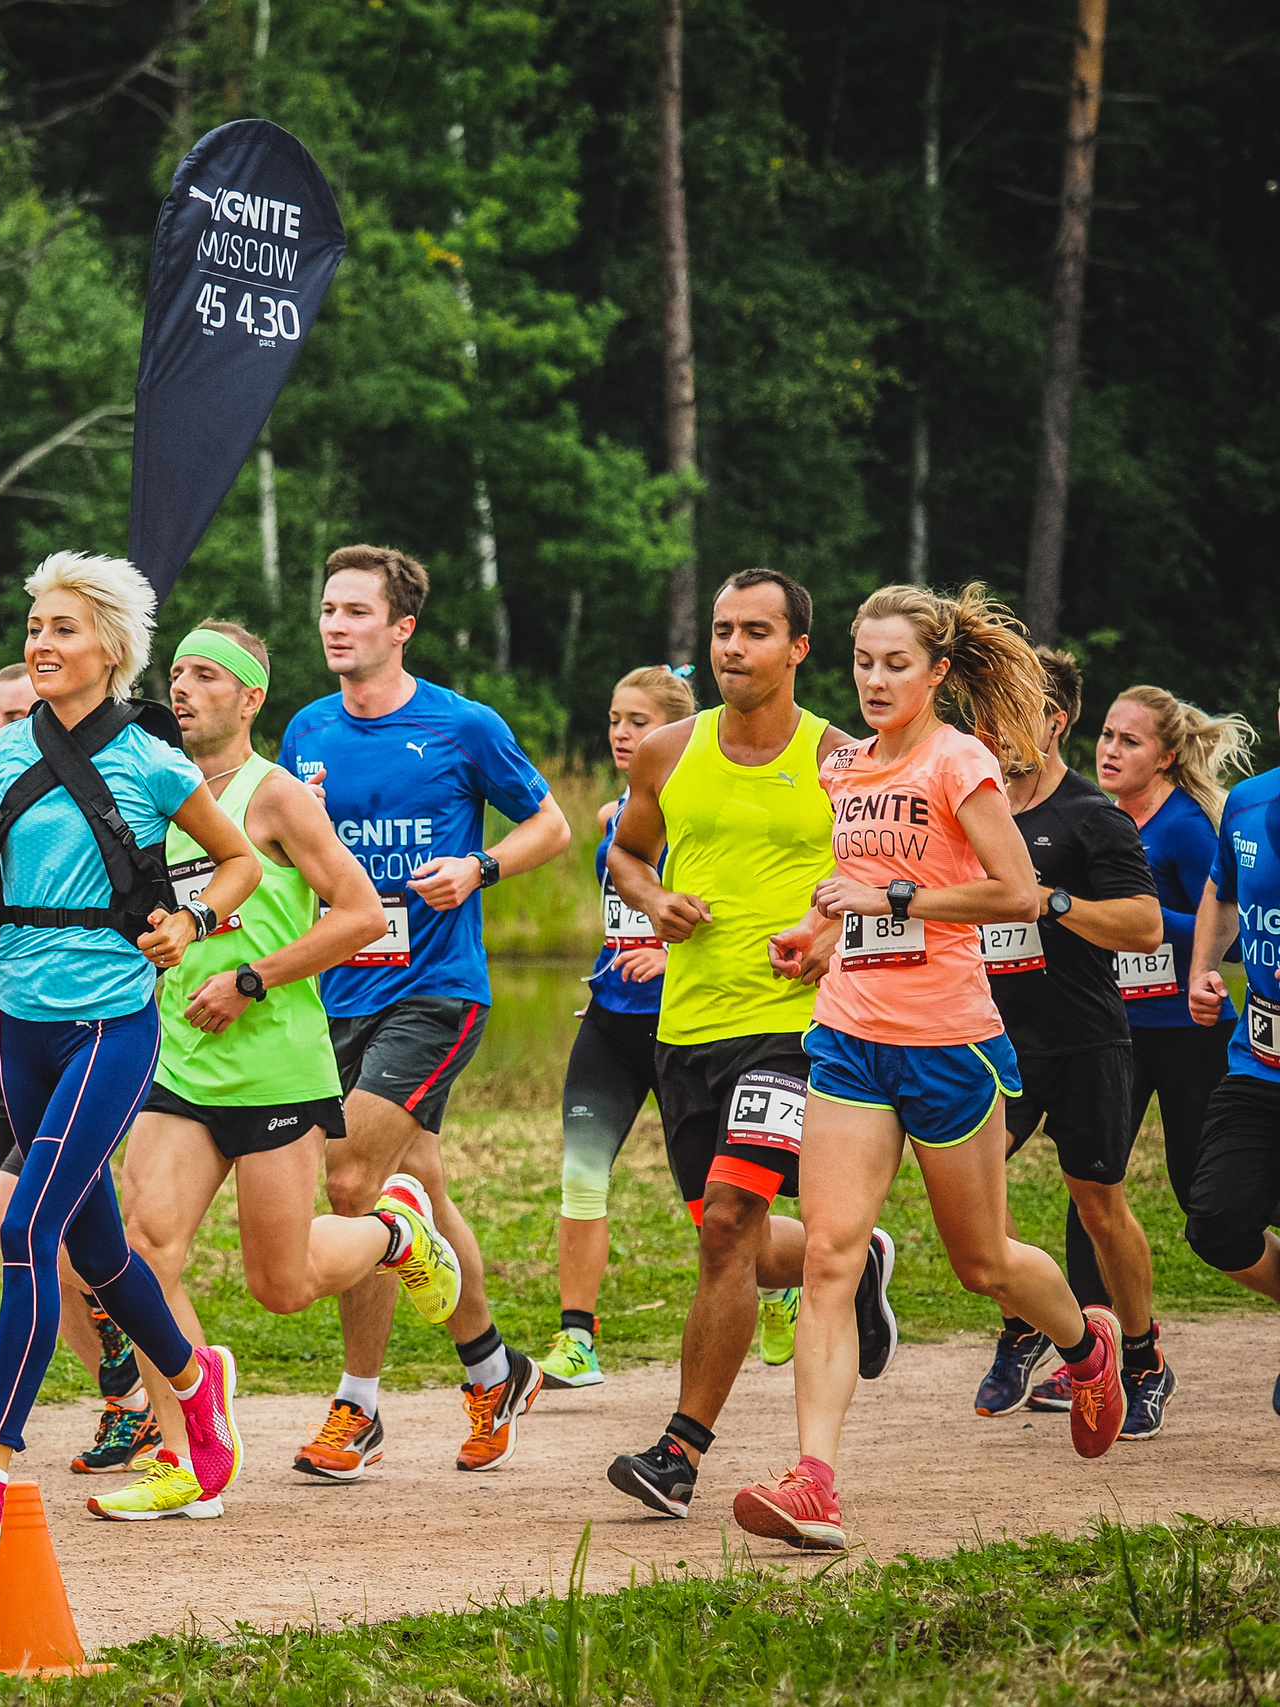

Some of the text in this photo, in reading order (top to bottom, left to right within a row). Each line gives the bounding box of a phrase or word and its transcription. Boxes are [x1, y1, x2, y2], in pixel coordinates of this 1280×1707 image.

[213, 188, 301, 240] IGNITE
[196, 229, 298, 282] MOSCOW
[195, 282, 301, 341] 45 4.30
[258, 338, 277, 348] pace
[838, 793, 929, 826] IGNITE
[875, 917, 905, 938] 85
[990, 927, 1028, 949] 277
[1120, 953, 1171, 975] 1187
[774, 1076, 803, 1091] MOSCOW
[276, 1115, 298, 1128] asics
